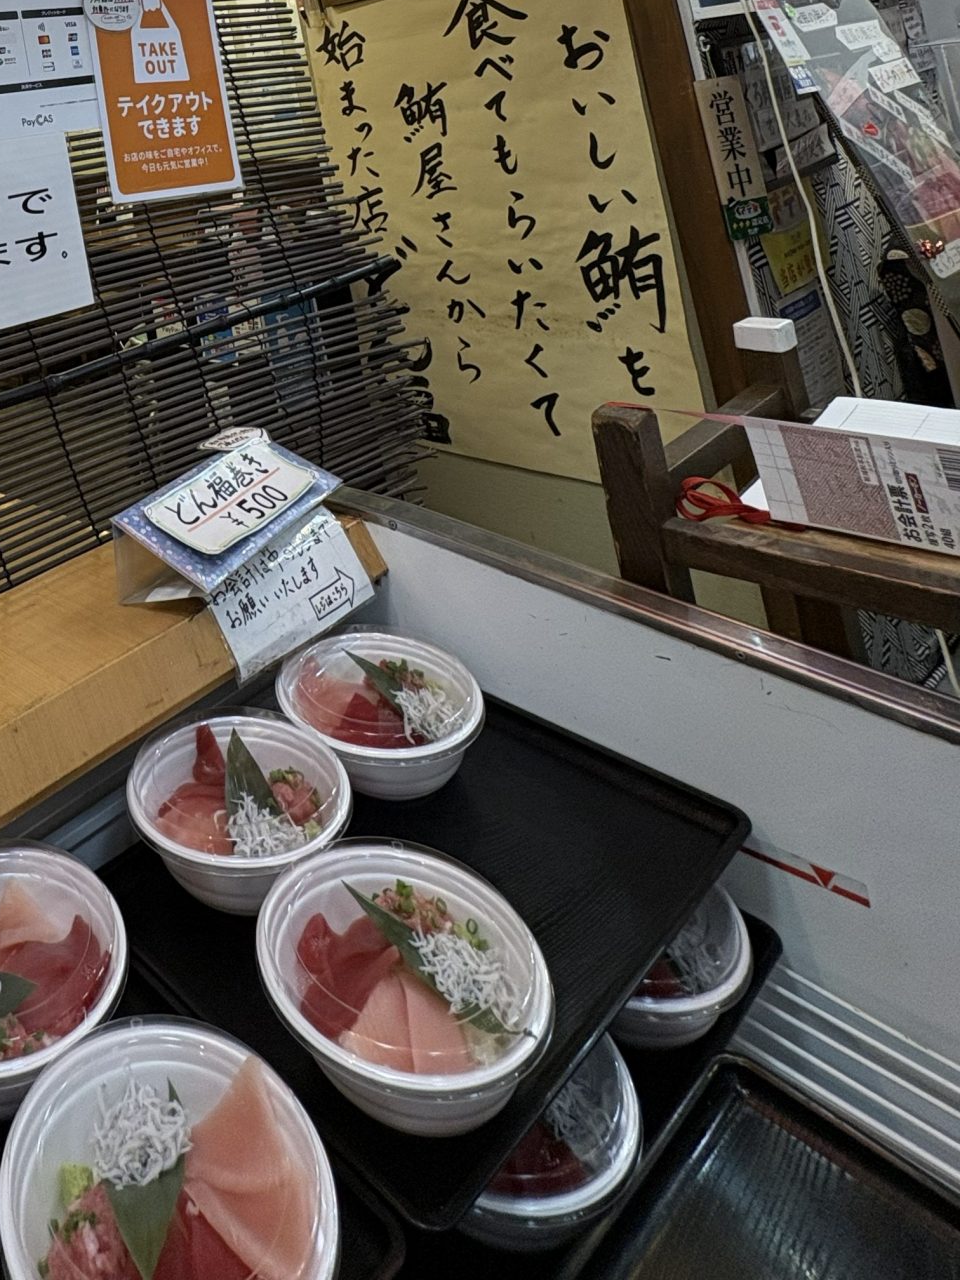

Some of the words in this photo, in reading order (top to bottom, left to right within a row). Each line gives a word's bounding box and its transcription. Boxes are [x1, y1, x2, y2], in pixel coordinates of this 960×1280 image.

[138, 41, 178, 58] TAKE
[144, 58, 176, 75] OUT
[117, 90, 213, 118] テイクアウト
[137, 114, 202, 140] できます
[315, 20, 390, 235] 始まった店
[708, 90, 754, 199] 営業中
[393, 81, 487, 385] 鮪屋さんから
[556, 23, 667, 397] おいしい鮪を
[164, 452, 271, 526] どん福巻き
[225, 557, 320, 629] お願いいたします
